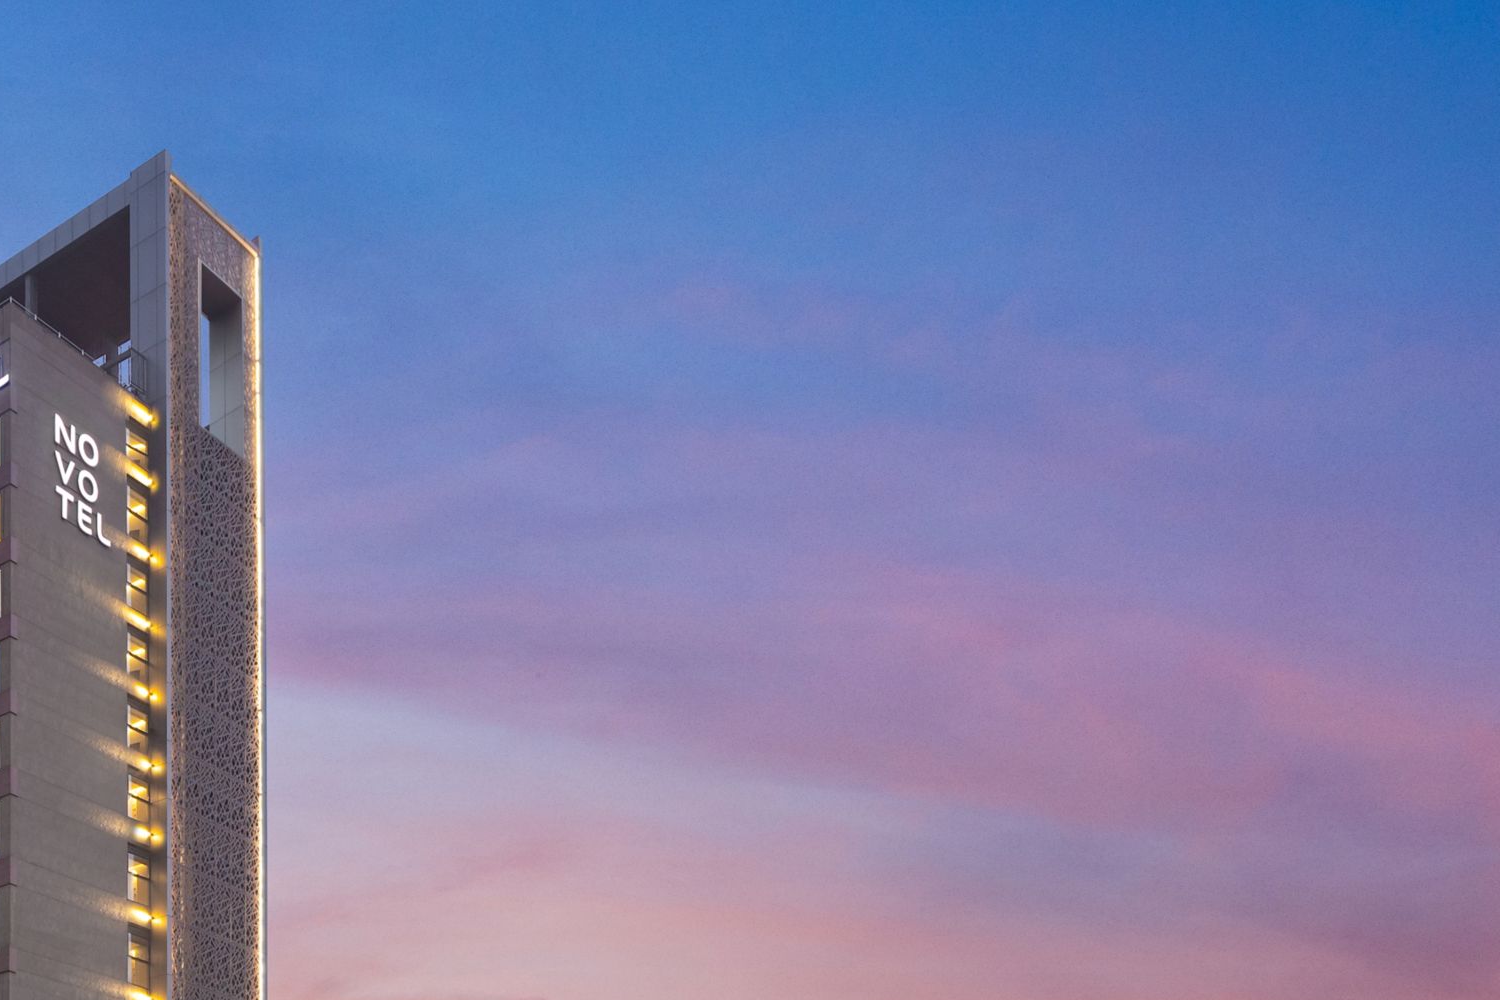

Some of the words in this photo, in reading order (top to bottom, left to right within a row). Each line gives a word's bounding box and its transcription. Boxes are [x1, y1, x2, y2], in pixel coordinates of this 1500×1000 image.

[54, 413, 99, 467] NO
[54, 450, 99, 503] VO
[55, 485, 112, 547] TEL
